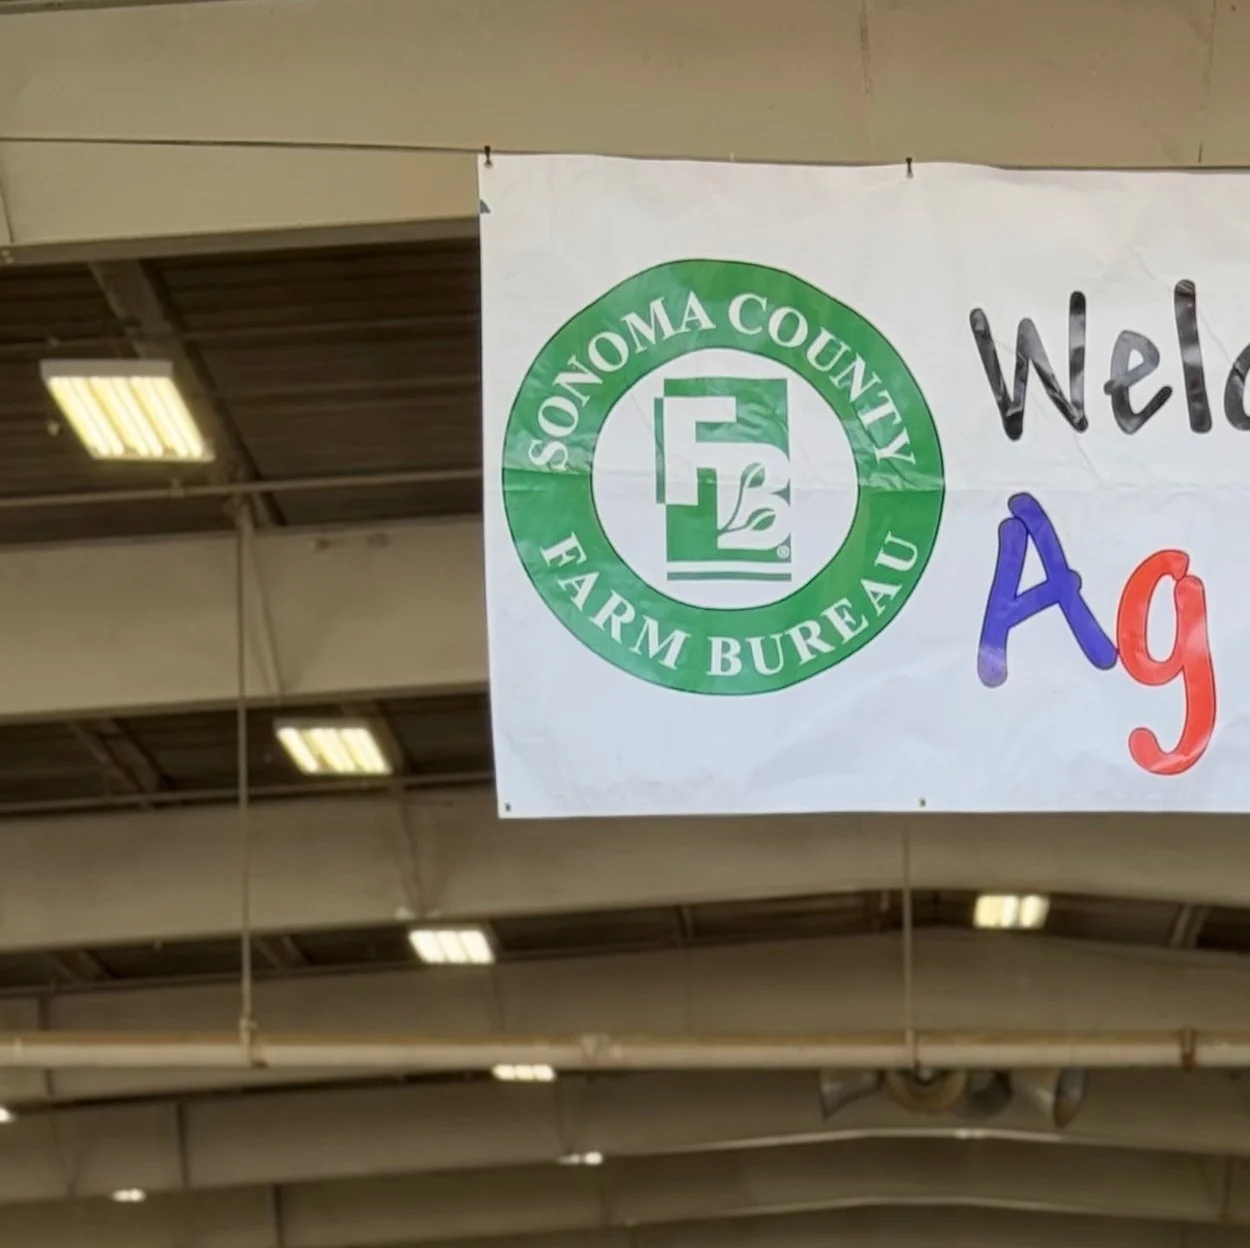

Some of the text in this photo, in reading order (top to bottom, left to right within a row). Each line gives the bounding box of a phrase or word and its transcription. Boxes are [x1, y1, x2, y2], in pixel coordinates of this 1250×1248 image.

[527, 290, 918, 474] SONOMA COUNTY
[540, 530, 920, 678] FARM BUREAU
[977, 492, 1218, 776] Ag
